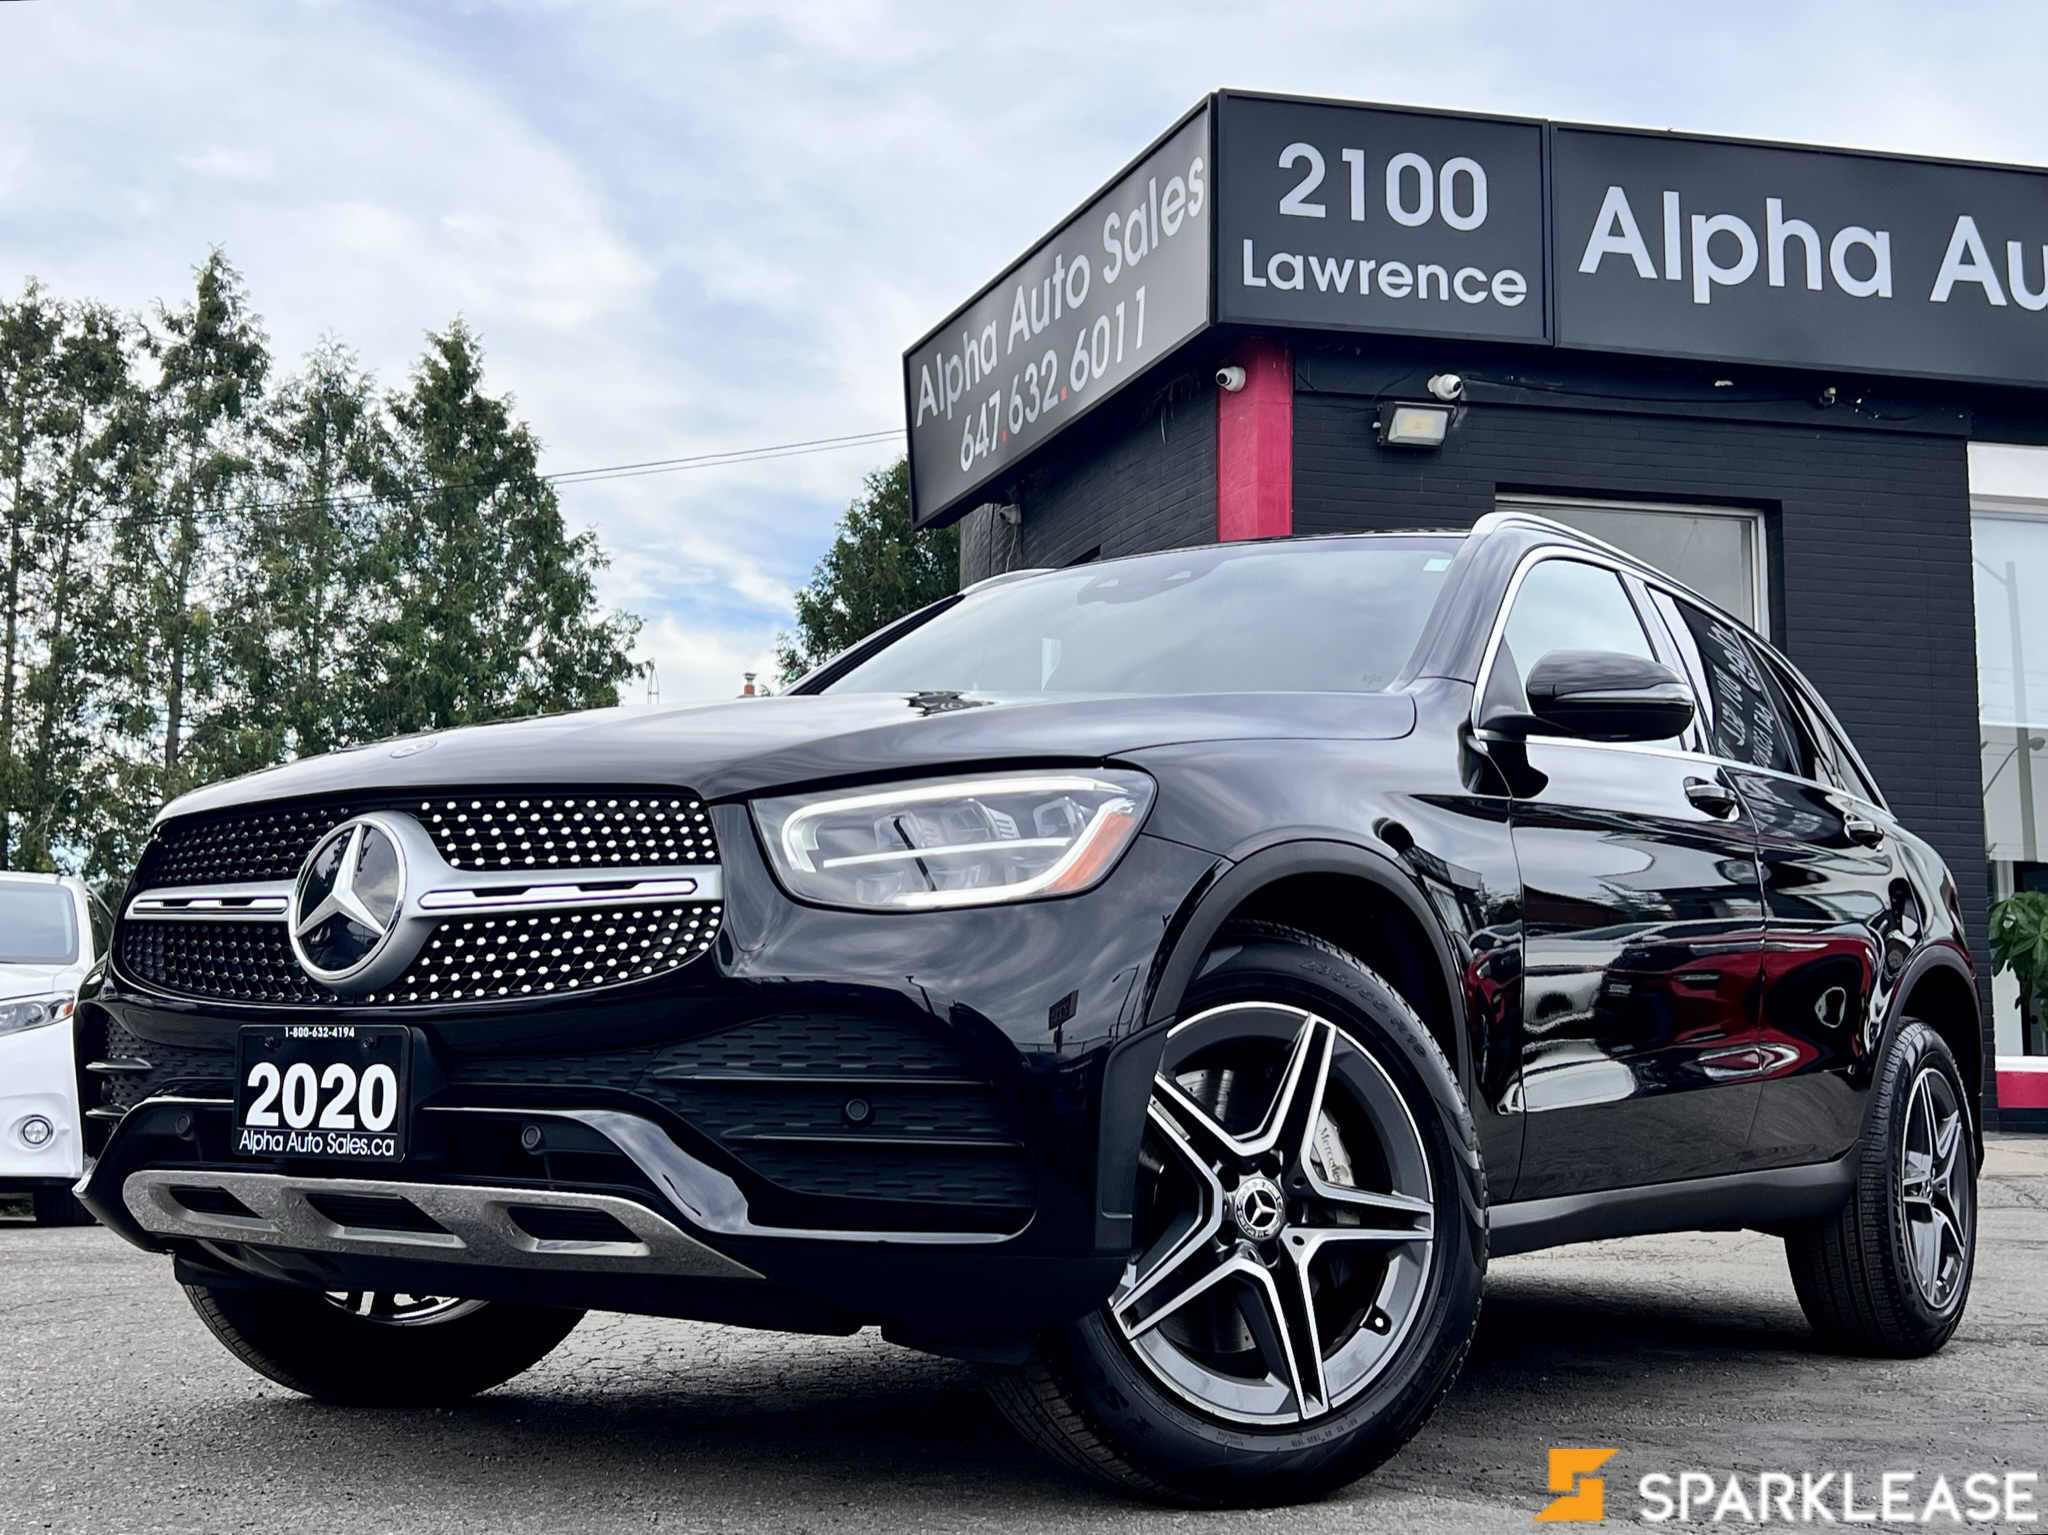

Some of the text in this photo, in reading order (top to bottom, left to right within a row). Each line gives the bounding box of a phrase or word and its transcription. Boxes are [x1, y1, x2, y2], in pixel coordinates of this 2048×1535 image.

[1278, 142, 1489, 231] 2100
[1243, 239, 1529, 307] Lawrence
[1578, 186, 2048, 311] Alpha Au
[917, 155, 1206, 427] Alpha Auto Sales
[959, 284, 1147, 473] 647.632.6011
[284, 1026, 355, 1039] 1-800-632-4194
[245, 1061, 398, 1132] 2020
[239, 1130, 395, 1157] Alpha Auto Sales.ca
